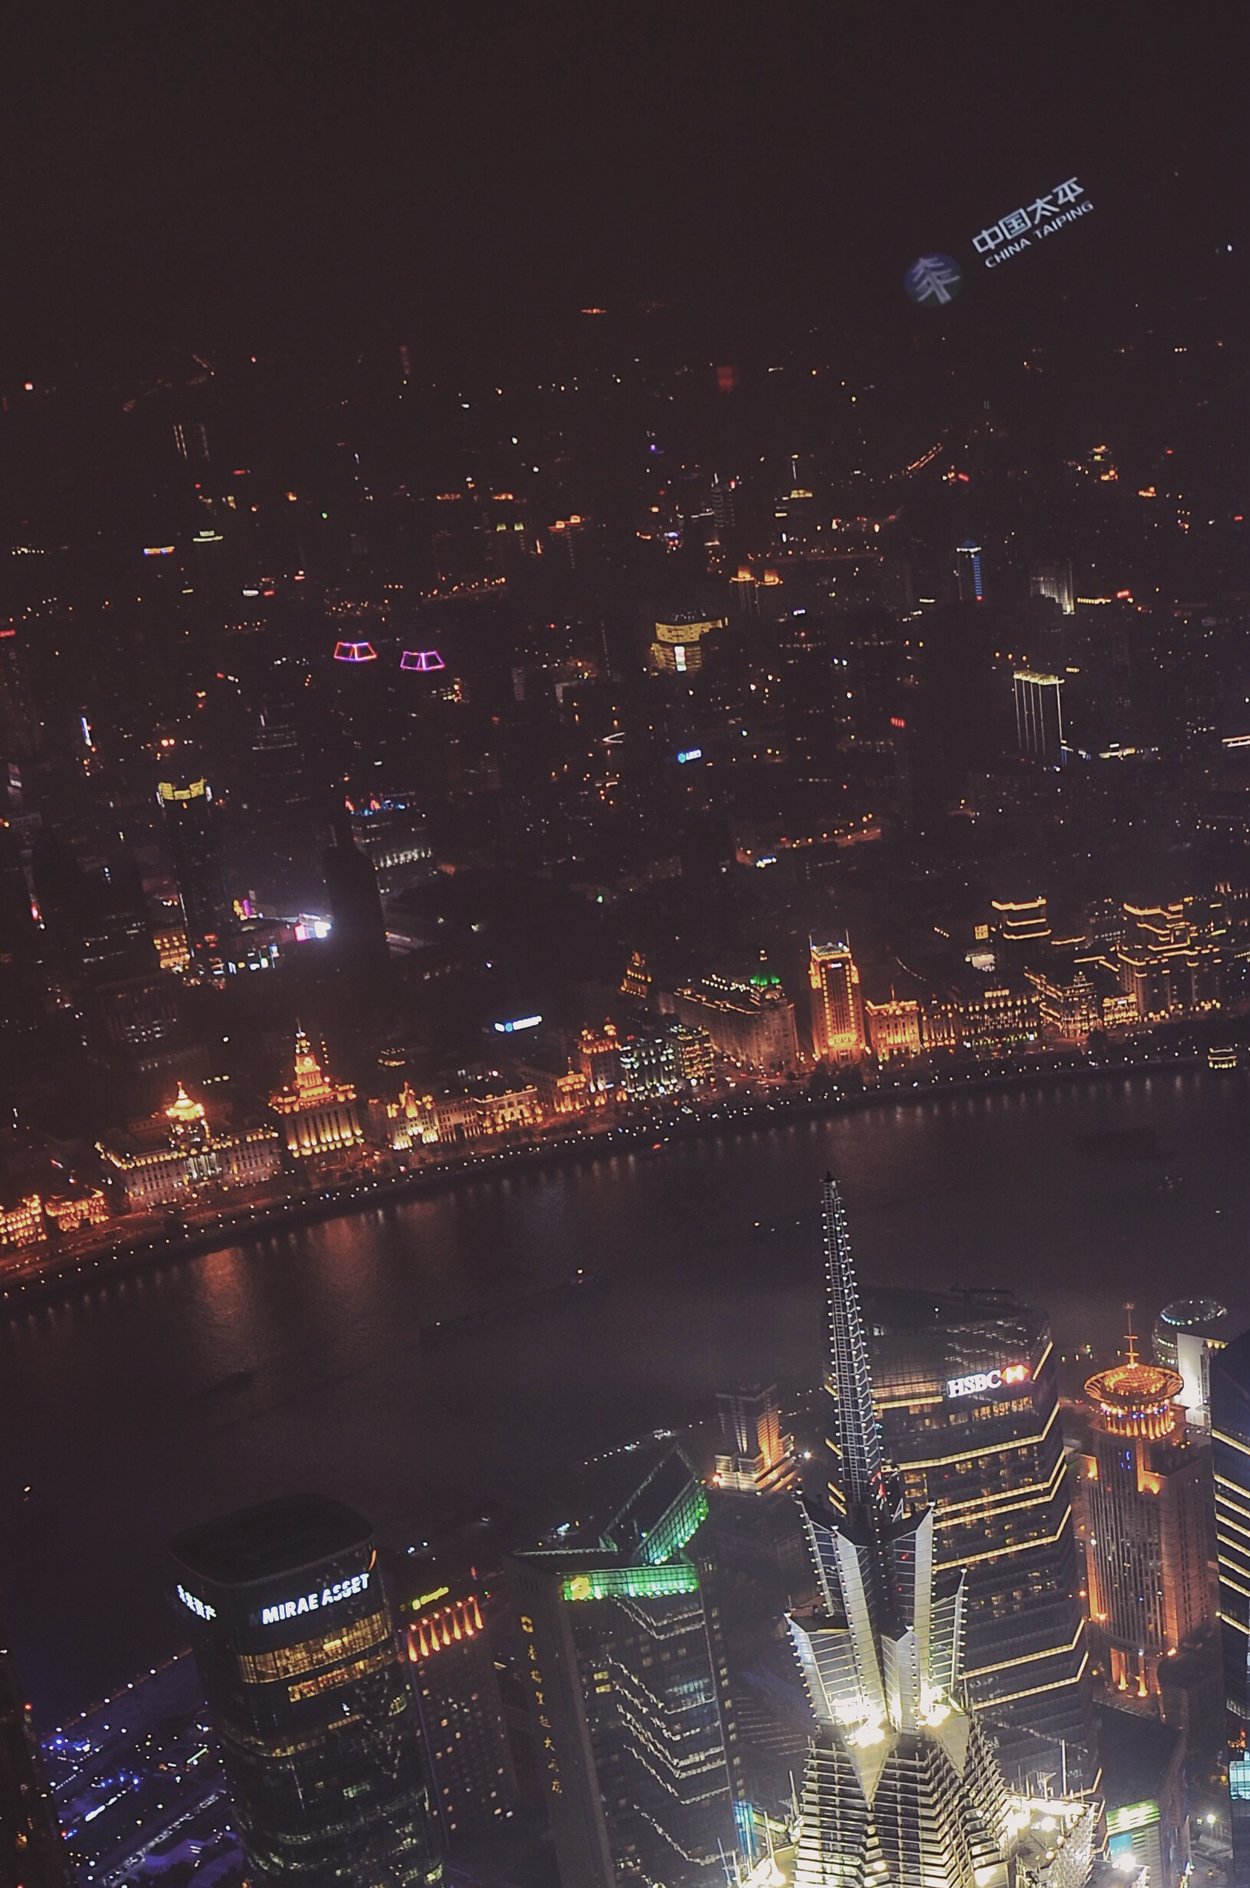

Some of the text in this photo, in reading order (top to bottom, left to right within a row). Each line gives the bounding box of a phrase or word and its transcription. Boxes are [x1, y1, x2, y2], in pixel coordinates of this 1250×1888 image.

[972, 177, 1084, 253] 中国太平
[985, 200, 1095, 269] CHINA TAIPING
[946, 1369, 1002, 1398] HSBC
[262, 1573, 370, 1625] MIRAE ASSET
